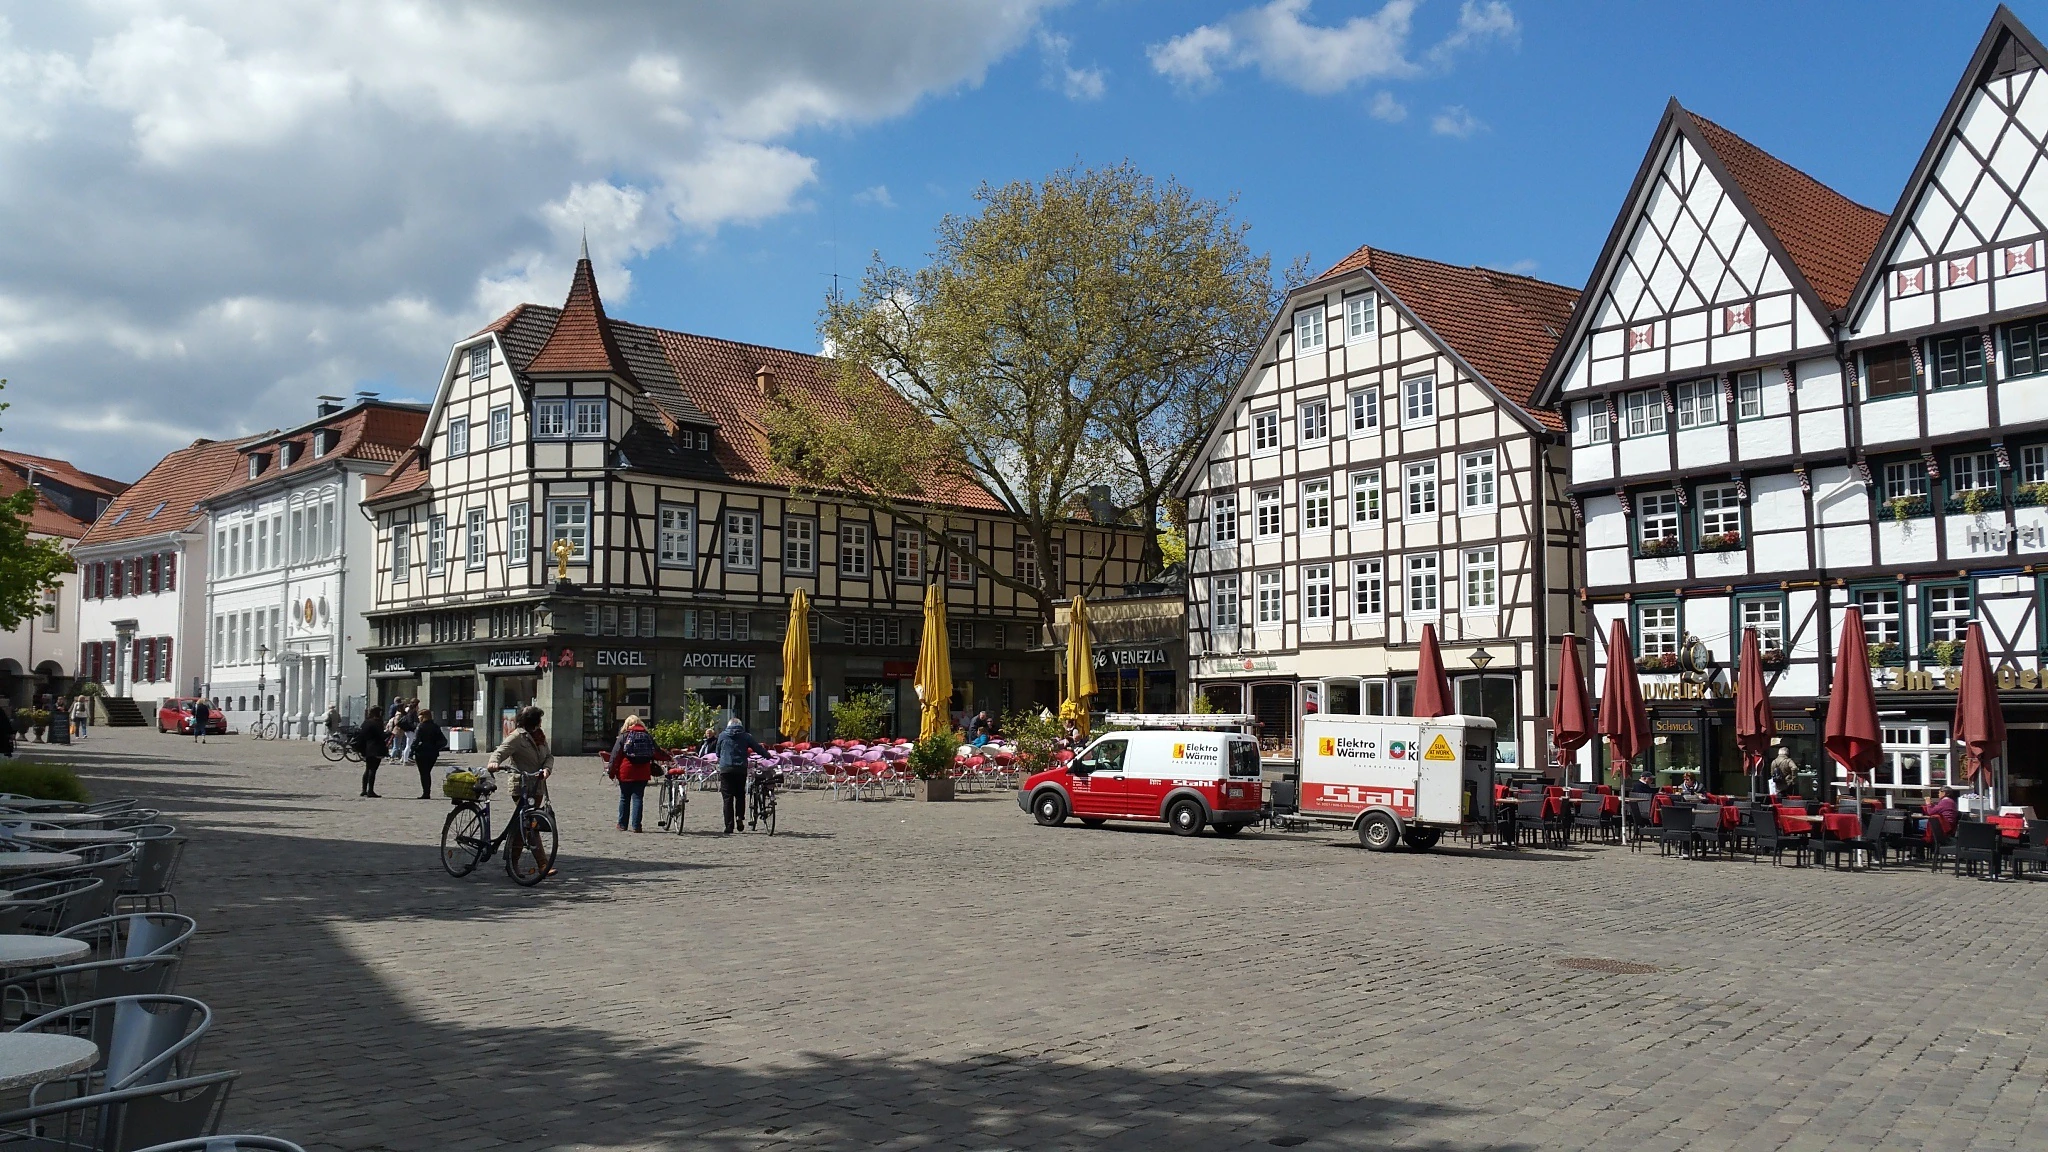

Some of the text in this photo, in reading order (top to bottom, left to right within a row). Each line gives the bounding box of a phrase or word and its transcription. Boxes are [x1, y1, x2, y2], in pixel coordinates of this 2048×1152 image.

[1966, 519, 2040, 546] Hotel
[385, 650, 531, 671] ENGEL APOTHEKE
[597, 650, 756, 669] ENGEL APOTHEKE
[1112, 649, 1166, 665] VENEZIA
[1642, 681, 1706, 701] JUWELIER
[1186, 743, 1219, 752] Elektro
[1337, 738, 1376, 749] Elektro
[1185, 752, 1218, 761] Wärme
[1336, 748, 1376, 759] Wärme
[1316, 785, 1415, 807] Stah
